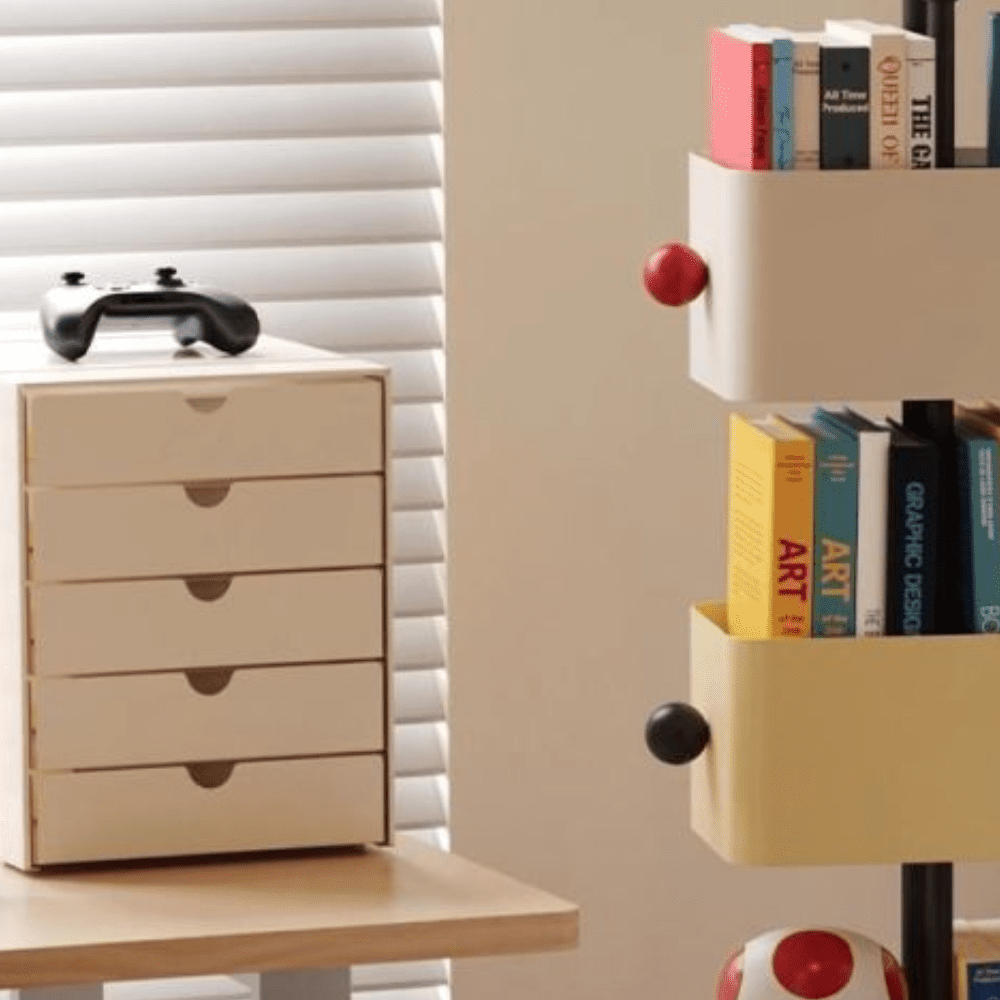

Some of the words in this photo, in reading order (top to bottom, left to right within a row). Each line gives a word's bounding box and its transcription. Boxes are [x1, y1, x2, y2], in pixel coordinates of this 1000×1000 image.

[911, 95, 932, 139] THE
[904, 481, 925, 569] GRAPHIC
[778, 537, 808, 603] ART
[821, 537, 850, 604] ART
